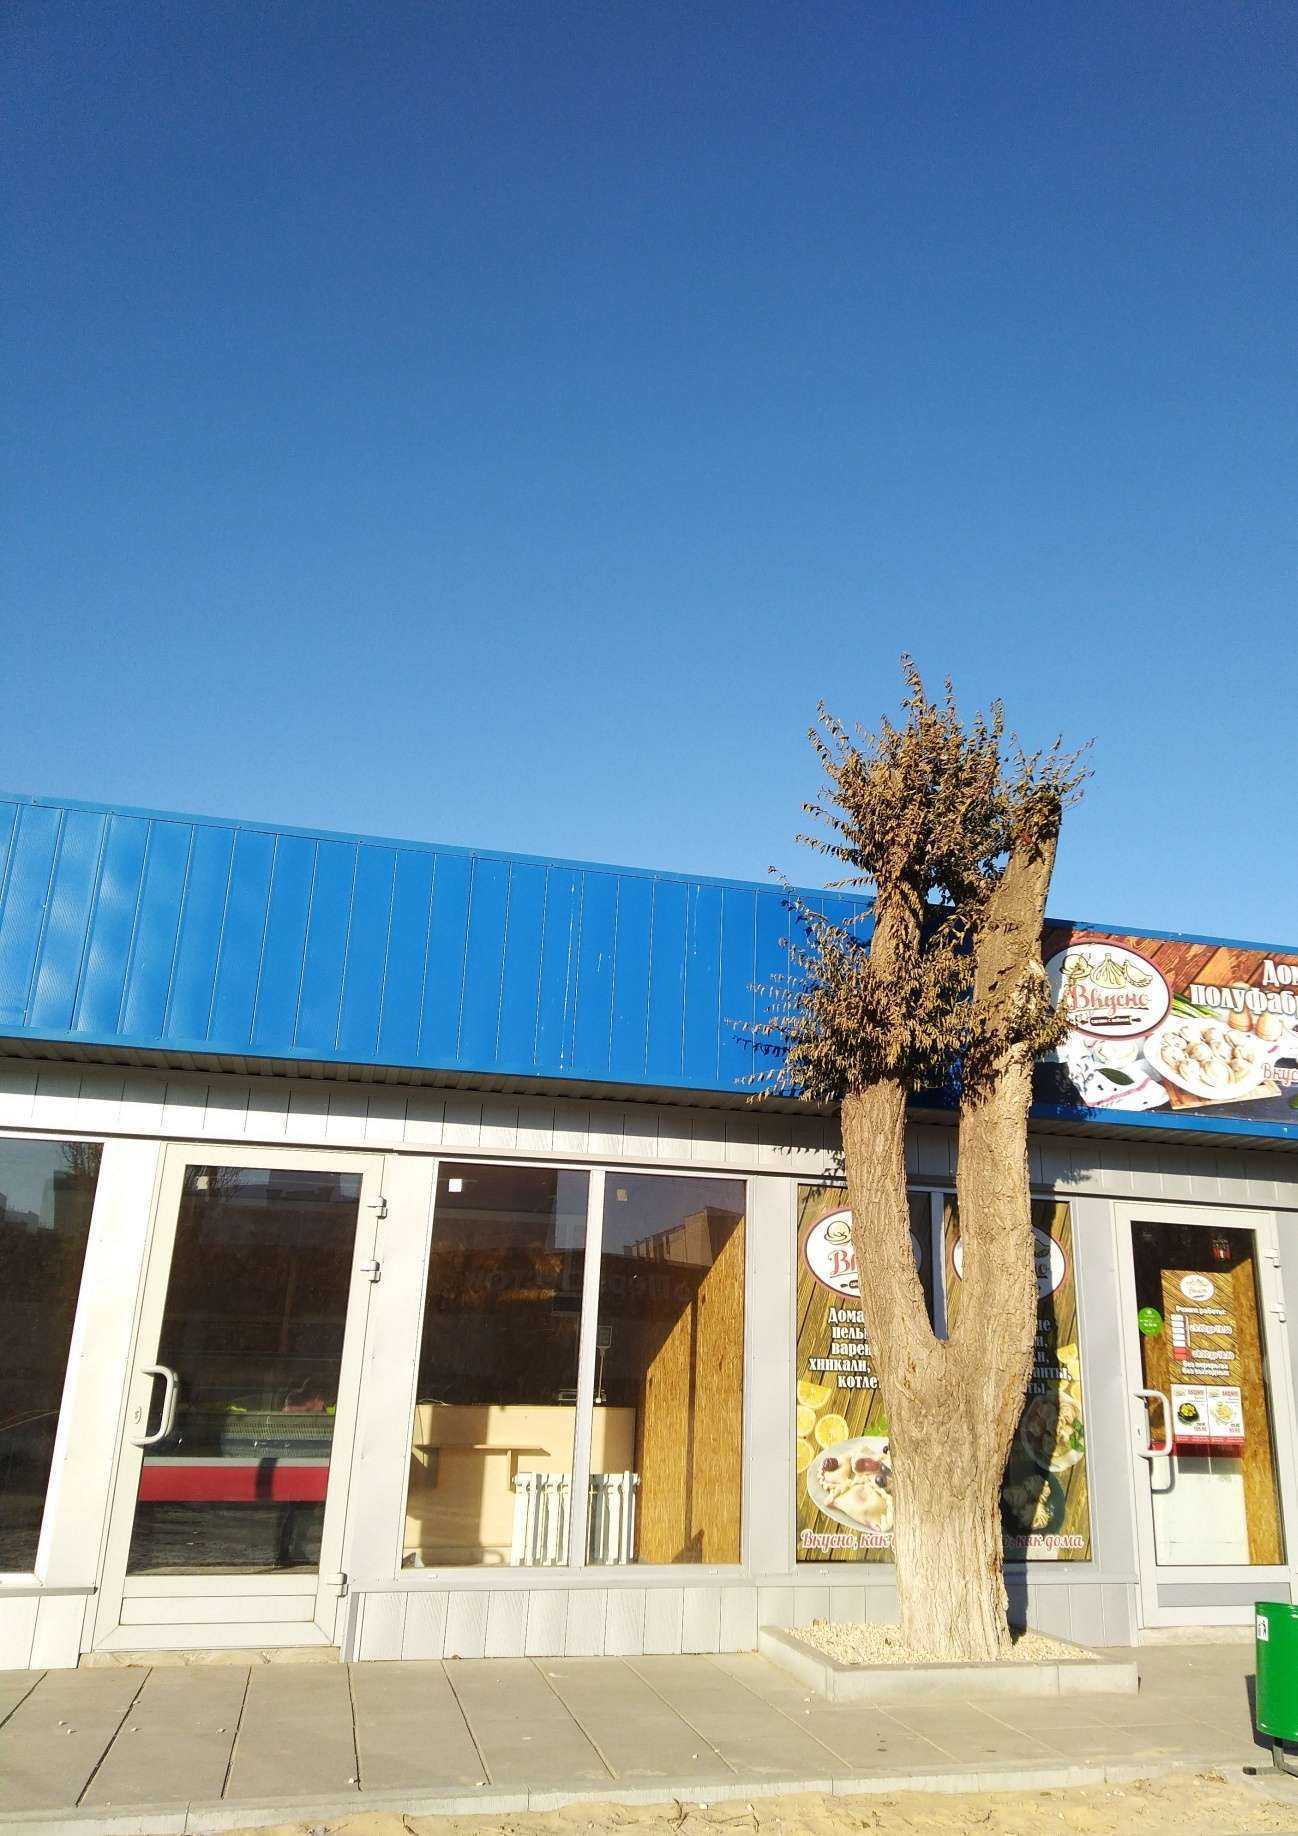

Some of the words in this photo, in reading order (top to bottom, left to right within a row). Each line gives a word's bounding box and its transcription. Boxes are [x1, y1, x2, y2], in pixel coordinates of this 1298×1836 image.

[832, 1326, 867, 1339] пель
[809, 1358, 871, 1373] хинкали,
[838, 1376, 881, 1389] котле
[801, 1530, 859, 1552] Вкусно,
[860, 1534, 890, 1548] как
[1044, 1535, 1085, 1551] дома
